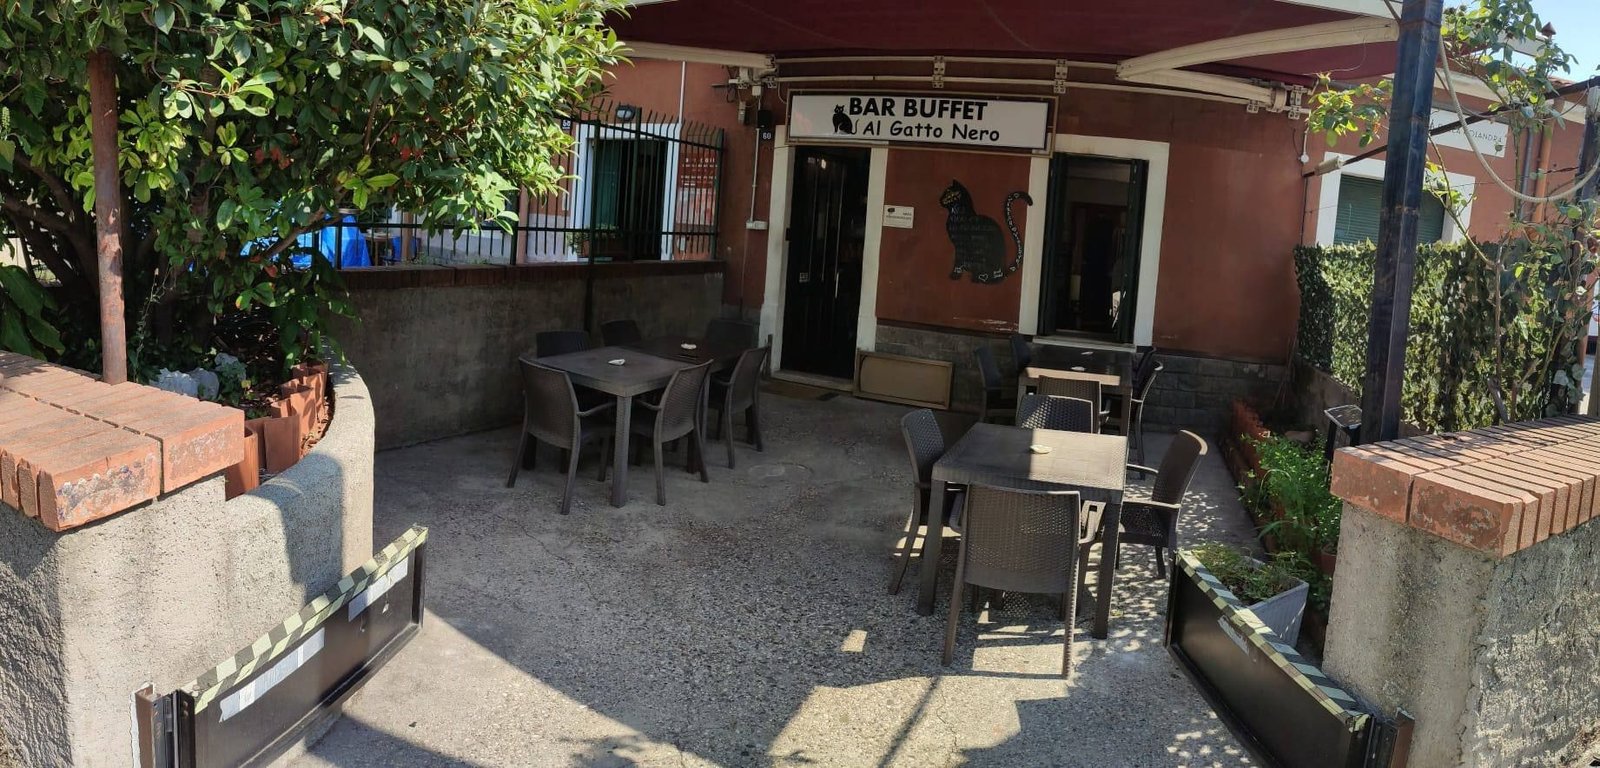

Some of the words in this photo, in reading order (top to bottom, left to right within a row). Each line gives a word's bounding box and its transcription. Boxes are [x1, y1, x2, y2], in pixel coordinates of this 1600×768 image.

[849, 97, 895, 116] BAR
[903, 98, 988, 121] BUFFET
[863, 120, 881, 136] Al
[890, 120, 943, 139] Gatto
[951, 123, 1000, 142] Nero
